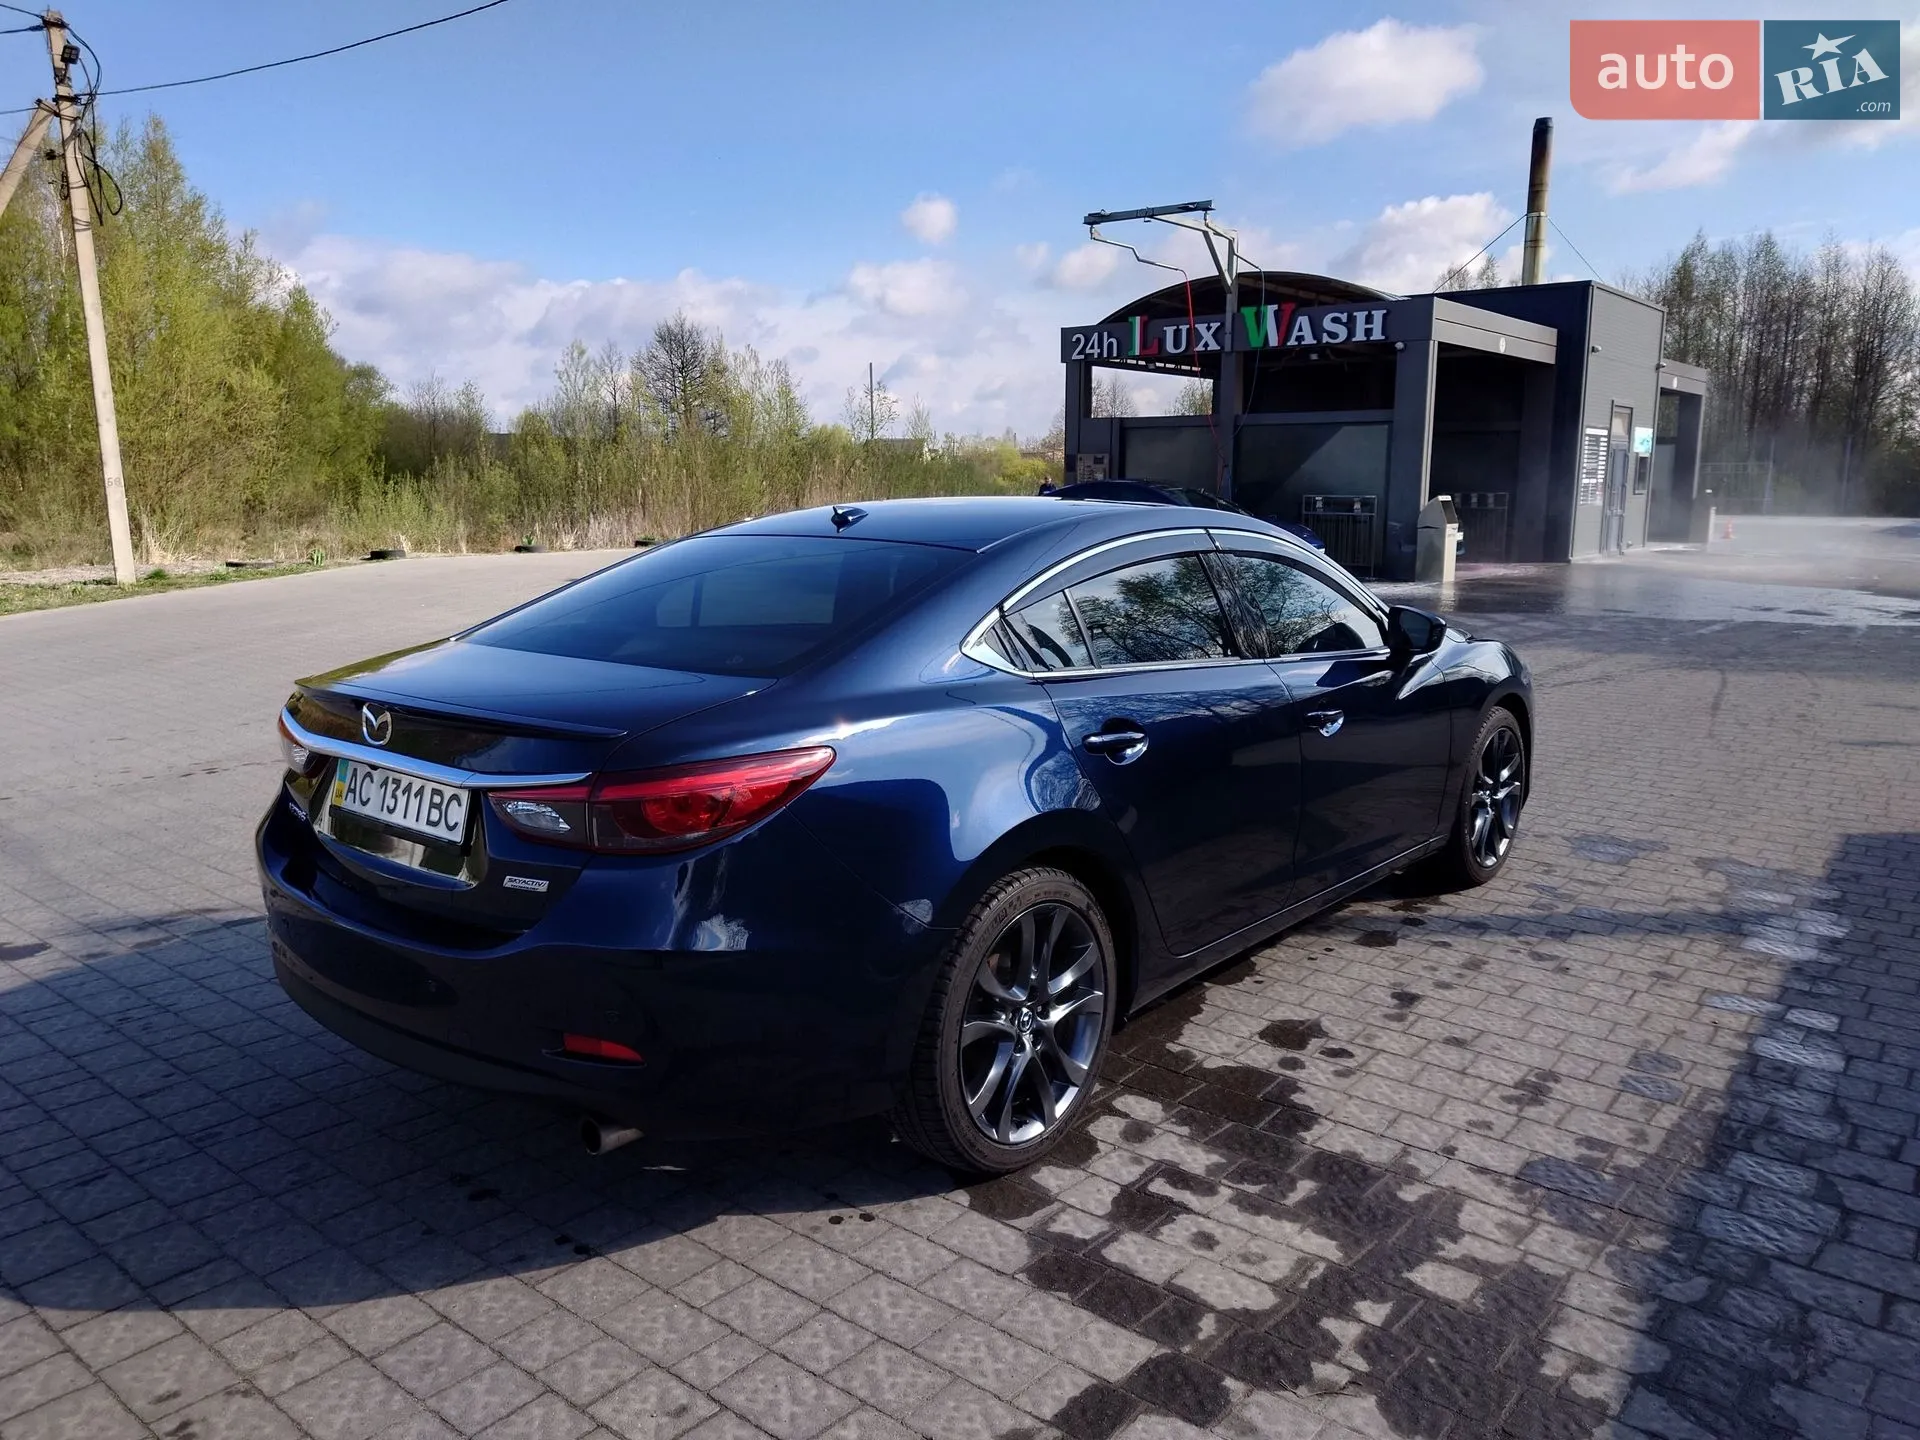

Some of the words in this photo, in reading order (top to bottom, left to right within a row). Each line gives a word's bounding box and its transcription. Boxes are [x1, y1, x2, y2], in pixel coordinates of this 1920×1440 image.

[1071, 331, 1119, 360] 24h
[1128, 314, 1222, 356] LUX
[1241, 302, 1388, 349] WASH
